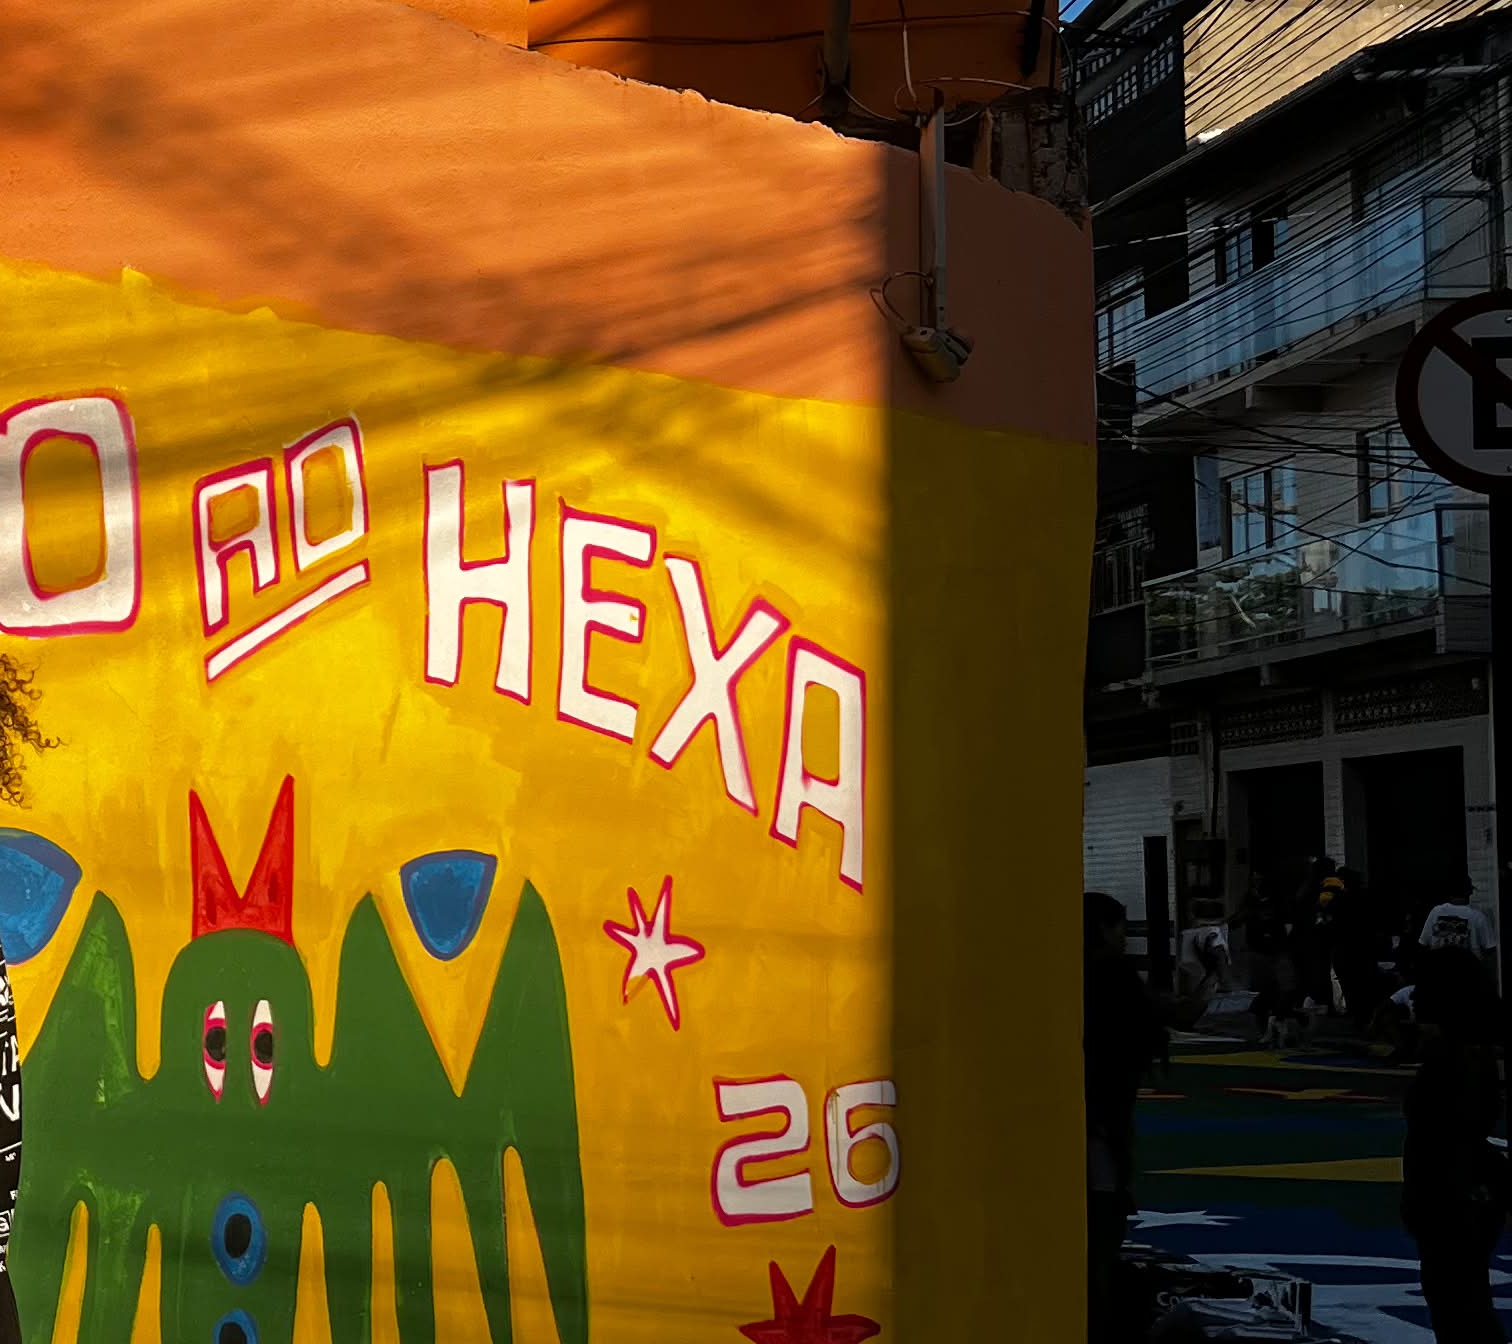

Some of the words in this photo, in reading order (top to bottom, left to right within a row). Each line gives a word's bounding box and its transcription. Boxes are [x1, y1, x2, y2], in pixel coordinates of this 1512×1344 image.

[193, 415, 369, 637] AO
[423, 458, 867, 895] HEXA
[711, 1073, 900, 1227] 26
